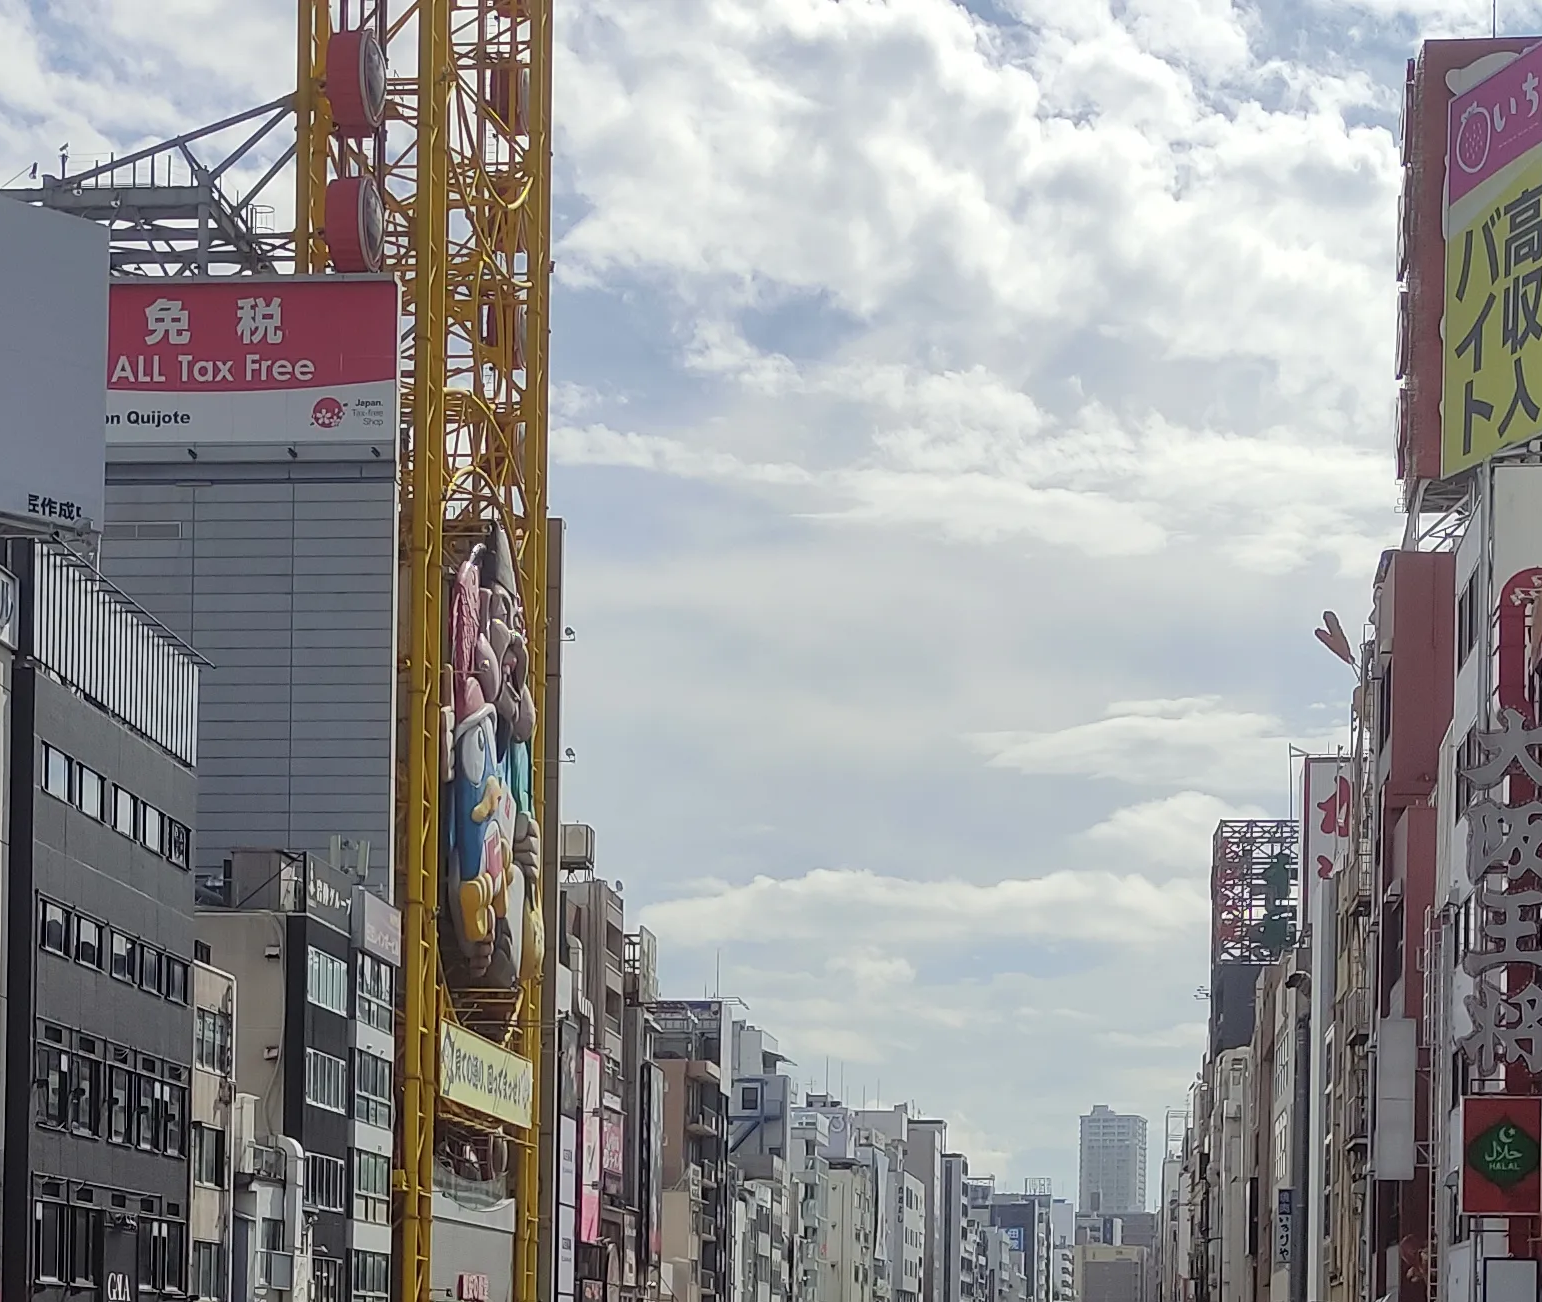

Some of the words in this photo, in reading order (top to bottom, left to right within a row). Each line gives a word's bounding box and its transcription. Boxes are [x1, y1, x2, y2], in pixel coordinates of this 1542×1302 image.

[144, 296, 283, 346] 免税
[1454, 208, 1502, 458] バイト
[111, 355, 166, 383] ALL
[178, 354, 235, 382] Tax
[245, 354, 316, 382] Free
[126, 410, 191, 428] Quijote
[1484, 1139, 1523, 1162] حلال
[1488, 1162, 1520, 1171] HALAL
